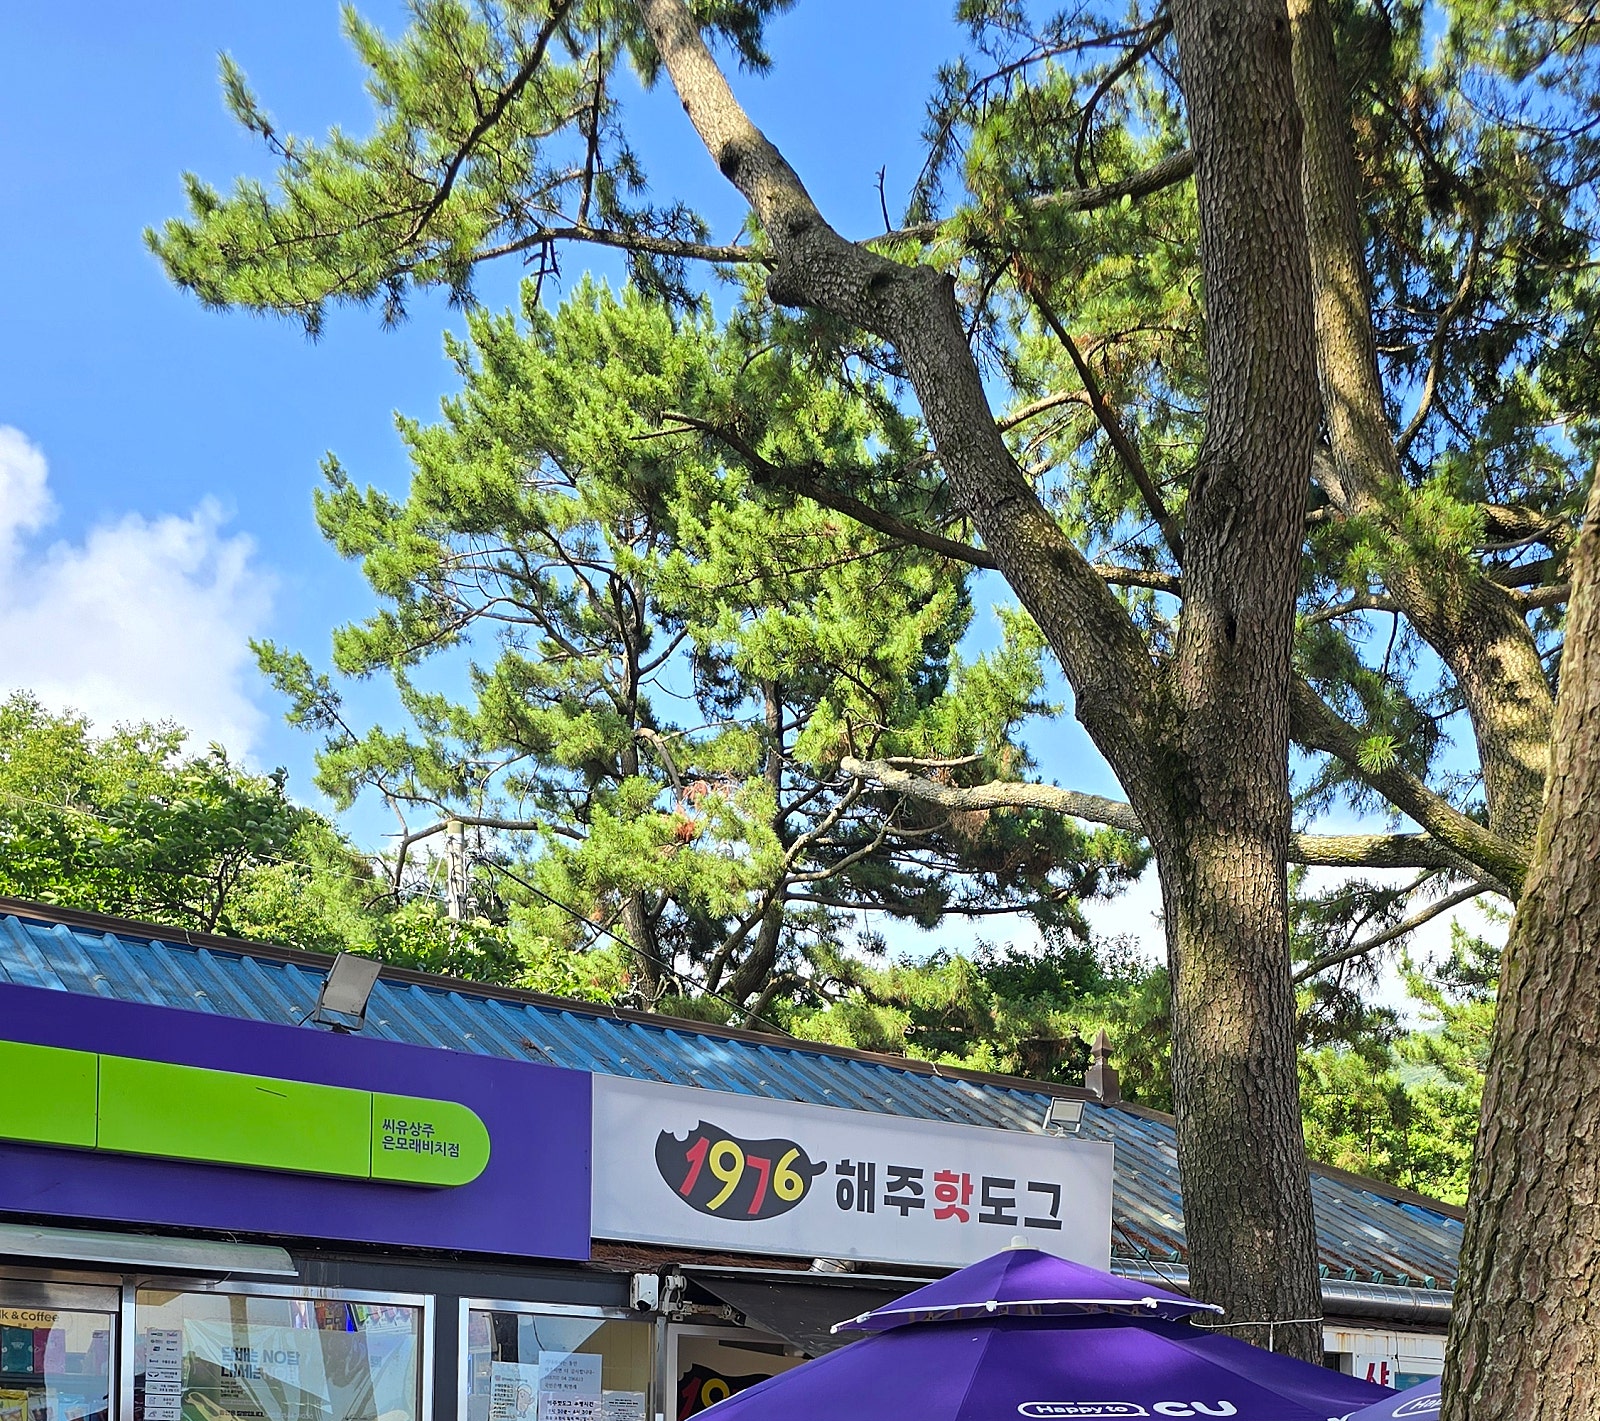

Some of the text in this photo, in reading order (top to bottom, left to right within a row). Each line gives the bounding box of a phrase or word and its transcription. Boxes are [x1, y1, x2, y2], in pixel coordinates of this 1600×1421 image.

[382, 1118, 435, 1138] 씨유상주
[382, 1135, 460, 1158] 은모래비치점
[679, 1136, 1063, 1231] 1976 해주핫도그
[21, 1311, 60, 1322] Coffee
[679, 1377, 734, 1421] 19
[1036, 1400, 1238, 1417] Happy to CU
[1409, 1398, 1442, 1411] Hap
